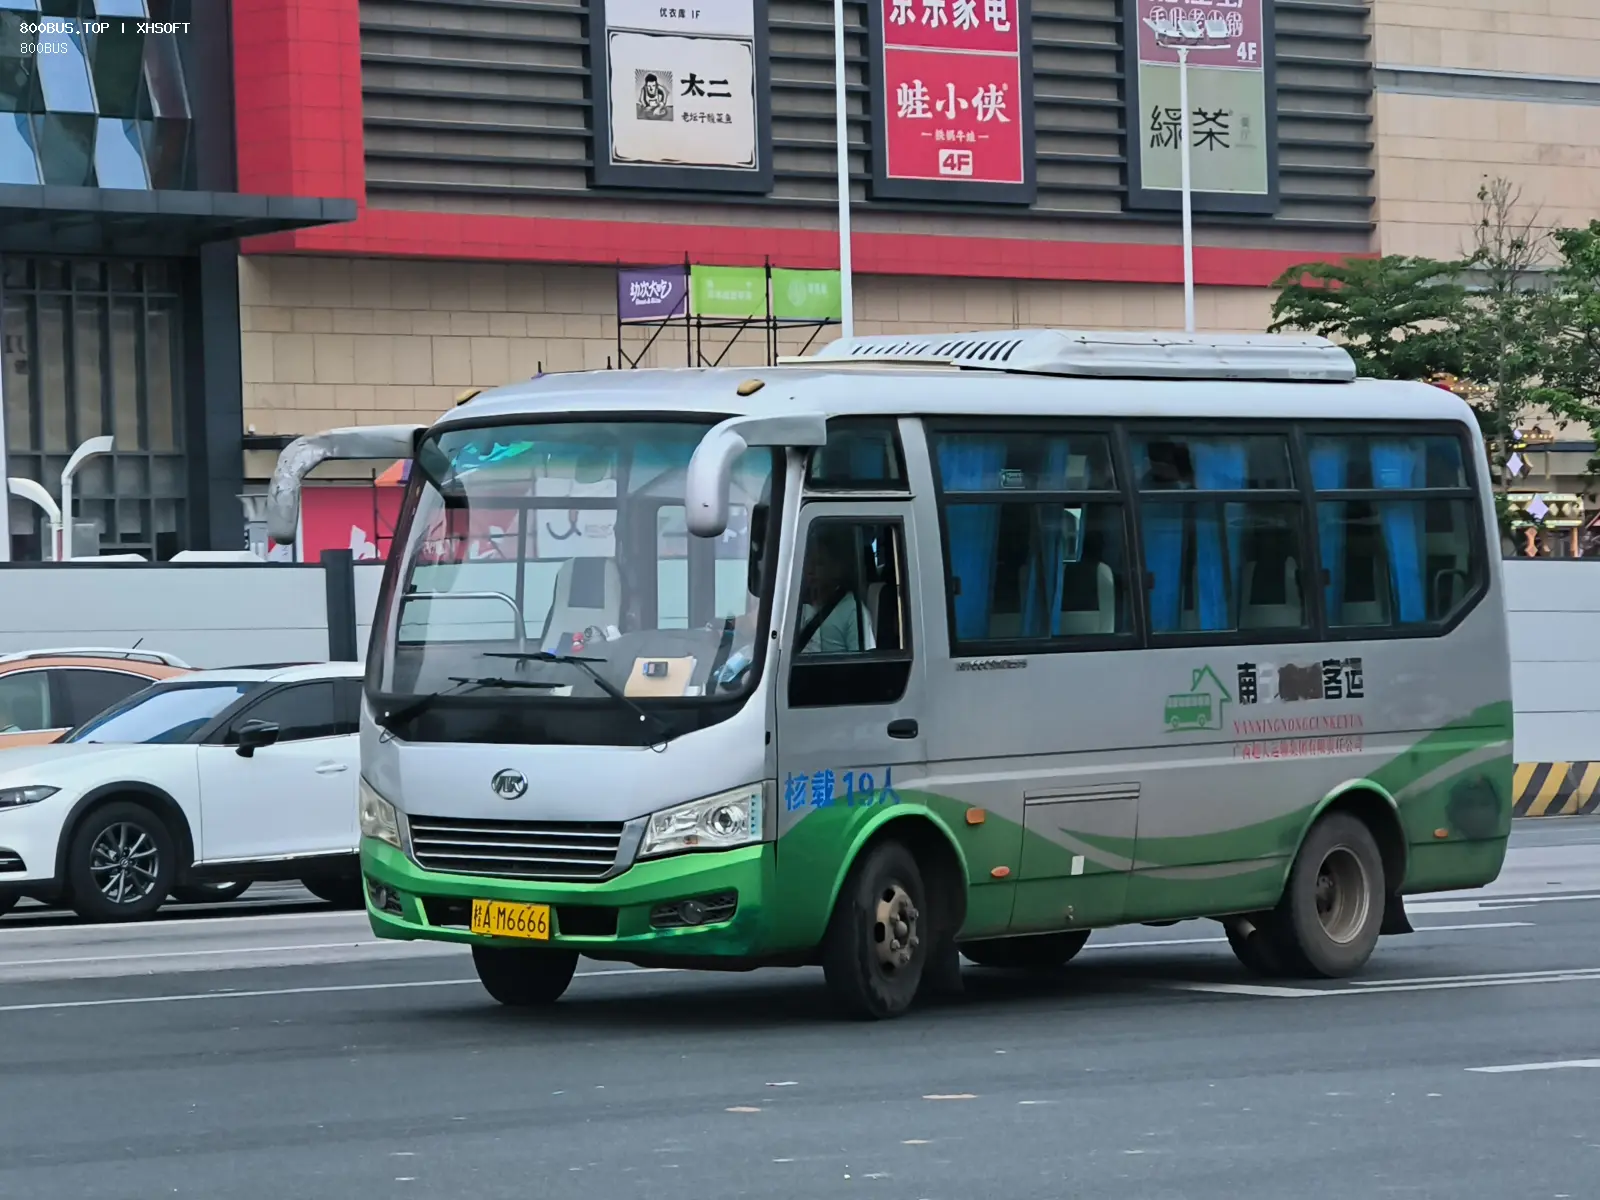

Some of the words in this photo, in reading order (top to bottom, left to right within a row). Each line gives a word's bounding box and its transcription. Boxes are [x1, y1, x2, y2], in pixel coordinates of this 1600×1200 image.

[659, 7, 686, 18] 优衣库
[1236, 41, 1257, 61] 4F
[680, 72, 732, 98] 太二
[896, 79, 1011, 122] 蛙小侠
[942, 153, 970, 171] 4F
